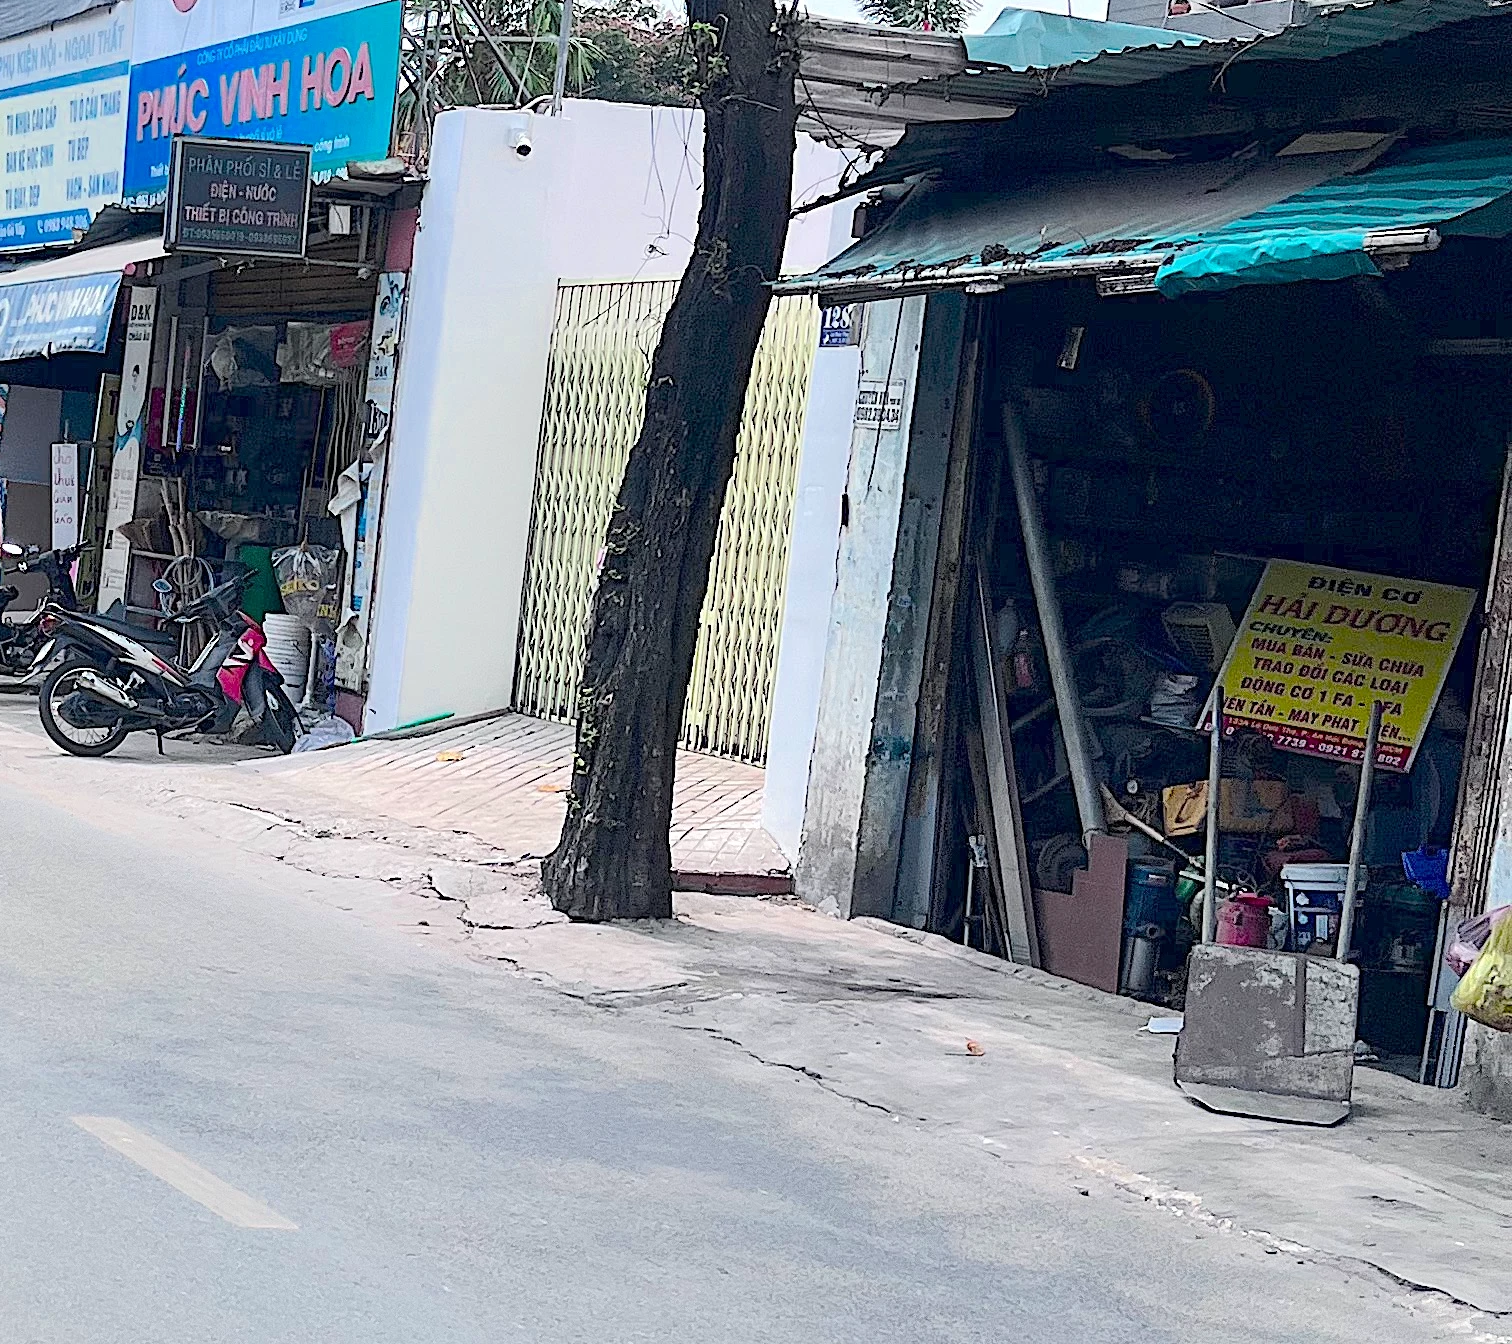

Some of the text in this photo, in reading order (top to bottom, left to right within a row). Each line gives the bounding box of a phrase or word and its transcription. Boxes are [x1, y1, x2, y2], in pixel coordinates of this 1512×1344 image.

[17, 43, 38, 76] KIỆN
[97, 18, 125, 52] THẤT
[136, 41, 374, 142] PHÚC VINH HOA
[188, 154, 224, 175] PHÂN
[226, 155, 256, 177] PHỐI
[273, 164, 283, 178] &
[210, 179, 238, 202] ĐIỆN
[245, 183, 277, 202] NƯỚC
[184, 202, 299, 229] THIẾT BỊ CÔNG TRÌNH
[131, 304, 151, 322] D&K
[1308, 575, 1424, 605] ĐIỆN CƠ
[1249, 618, 1335, 644] CHUYÊN:
[1257, 592, 1452, 644] HẢI DƯƠNG
[1251, 637, 1289, 655] MUA
[1291, 639, 1326, 662] BÁN
[1252, 655, 1294, 676] TRAO
[1297, 660, 1329, 682] ĐỔI
[1368, 676, 1410, 698] LOẠI
[1240, 675, 1286, 697] ĐỘNG
[1289, 683, 1316, 701] CƠ
[1319, 690, 1328, 703] 1
[1332, 692, 1355, 709] FA
